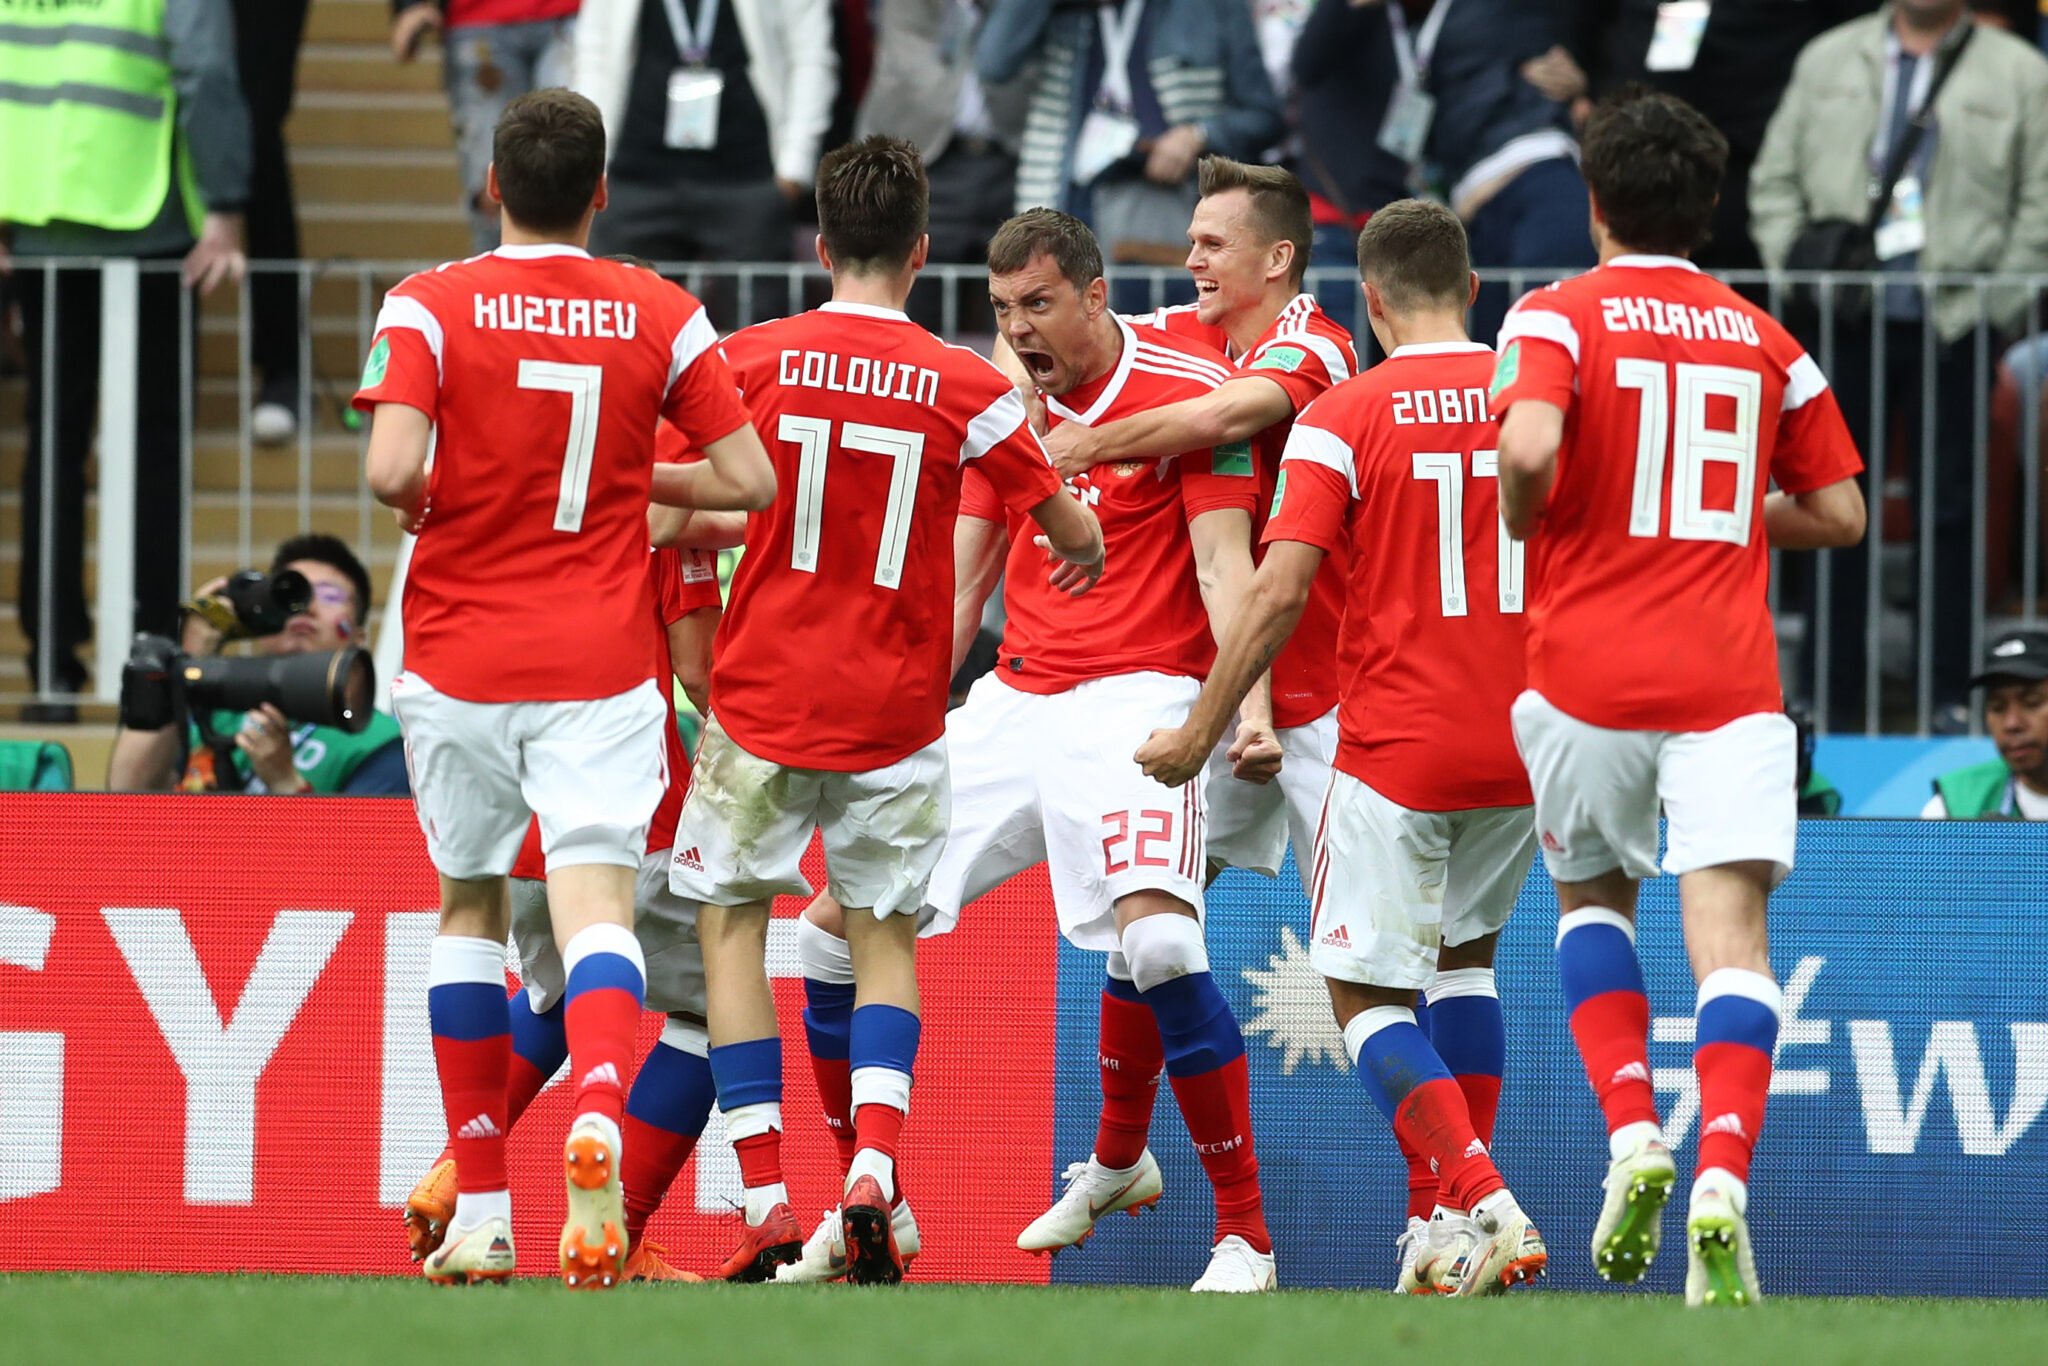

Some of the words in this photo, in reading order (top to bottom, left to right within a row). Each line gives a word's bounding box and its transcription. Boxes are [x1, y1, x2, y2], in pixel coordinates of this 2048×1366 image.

[474, 293, 637, 340] KUZIAEV
[1600, 297, 1761, 346] ZHIRKOV
[778, 349, 939, 406] GOLOVIN
[517, 359, 603, 533] 7
[1615, 358, 1762, 547] 18
[778, 413, 926, 591] 17
[674, 856, 705, 872] adidas
[1102, 809, 1173, 876] 22
